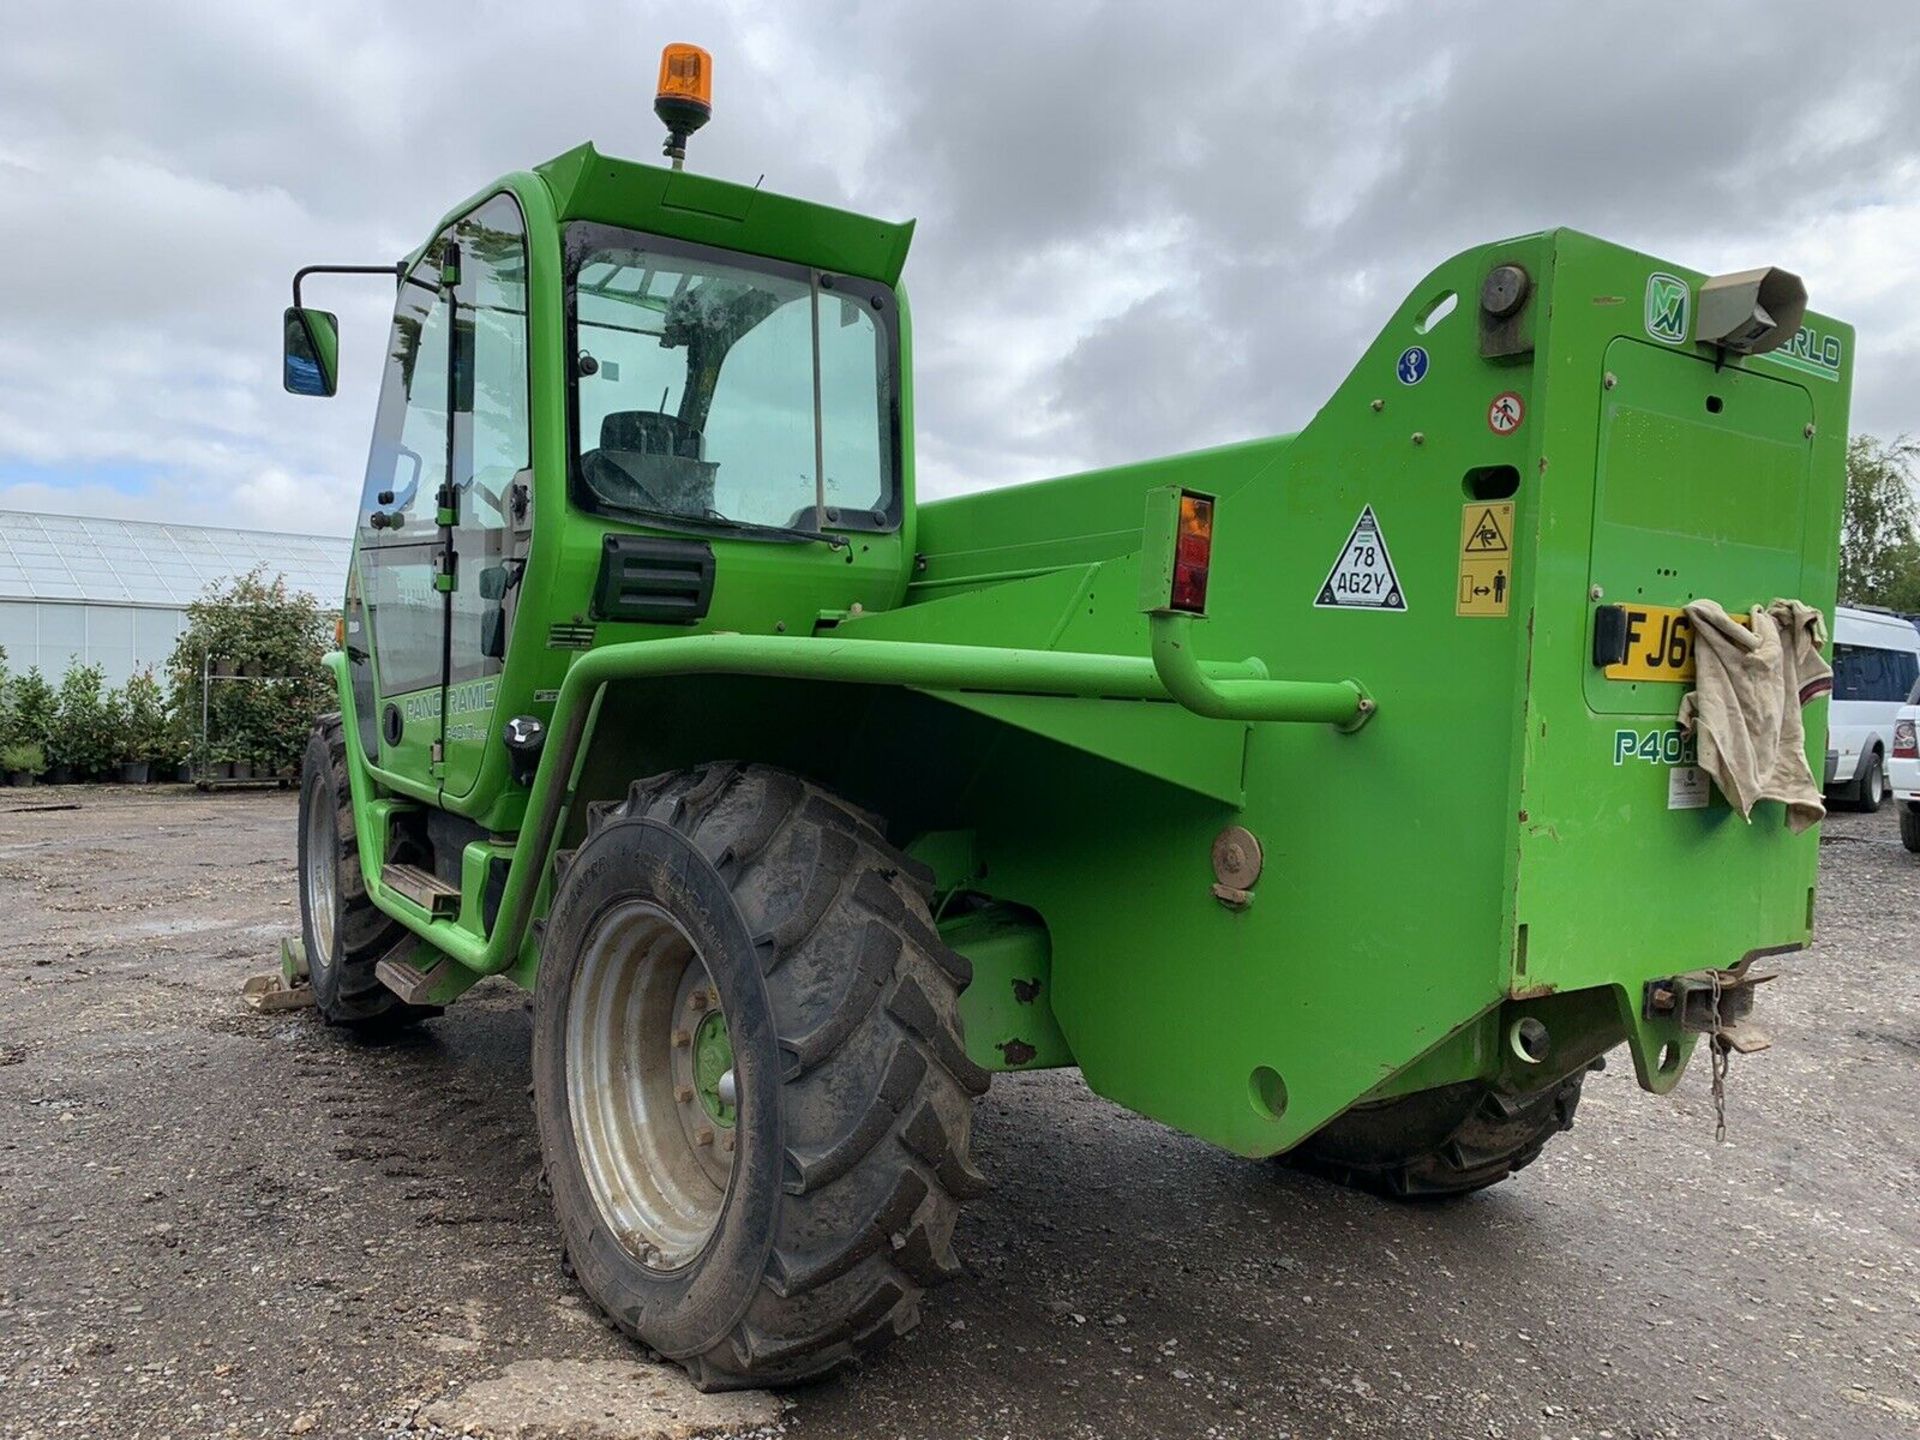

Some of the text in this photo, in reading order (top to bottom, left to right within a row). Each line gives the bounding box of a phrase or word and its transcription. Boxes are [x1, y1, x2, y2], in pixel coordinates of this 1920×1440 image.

[1354, 547, 1375, 567] 78
[1337, 573, 1385, 594] AG2Y
[1624, 612, 1694, 668] FJ6
[406, 680, 494, 723] PANORAMIC
